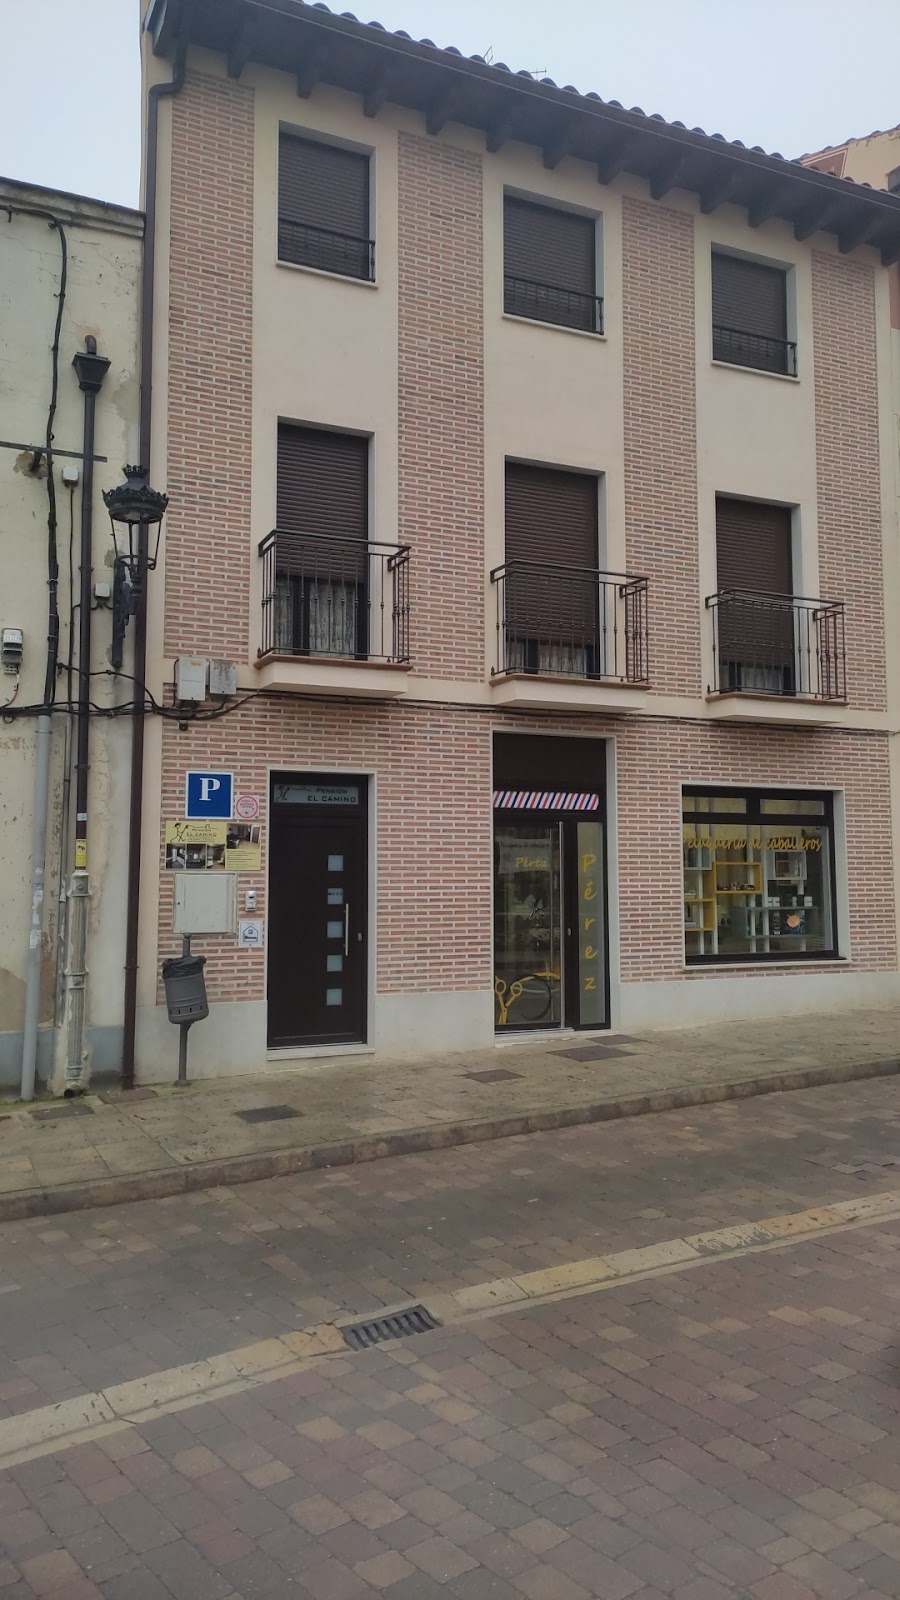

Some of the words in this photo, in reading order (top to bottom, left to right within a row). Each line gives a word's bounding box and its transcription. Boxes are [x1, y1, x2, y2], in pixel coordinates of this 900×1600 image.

[199, 777, 221, 801] P
[321, 795, 356, 803] CAMINO
[515, 856, 548, 869] Pérez
[581, 854, 598, 990] Pérez
